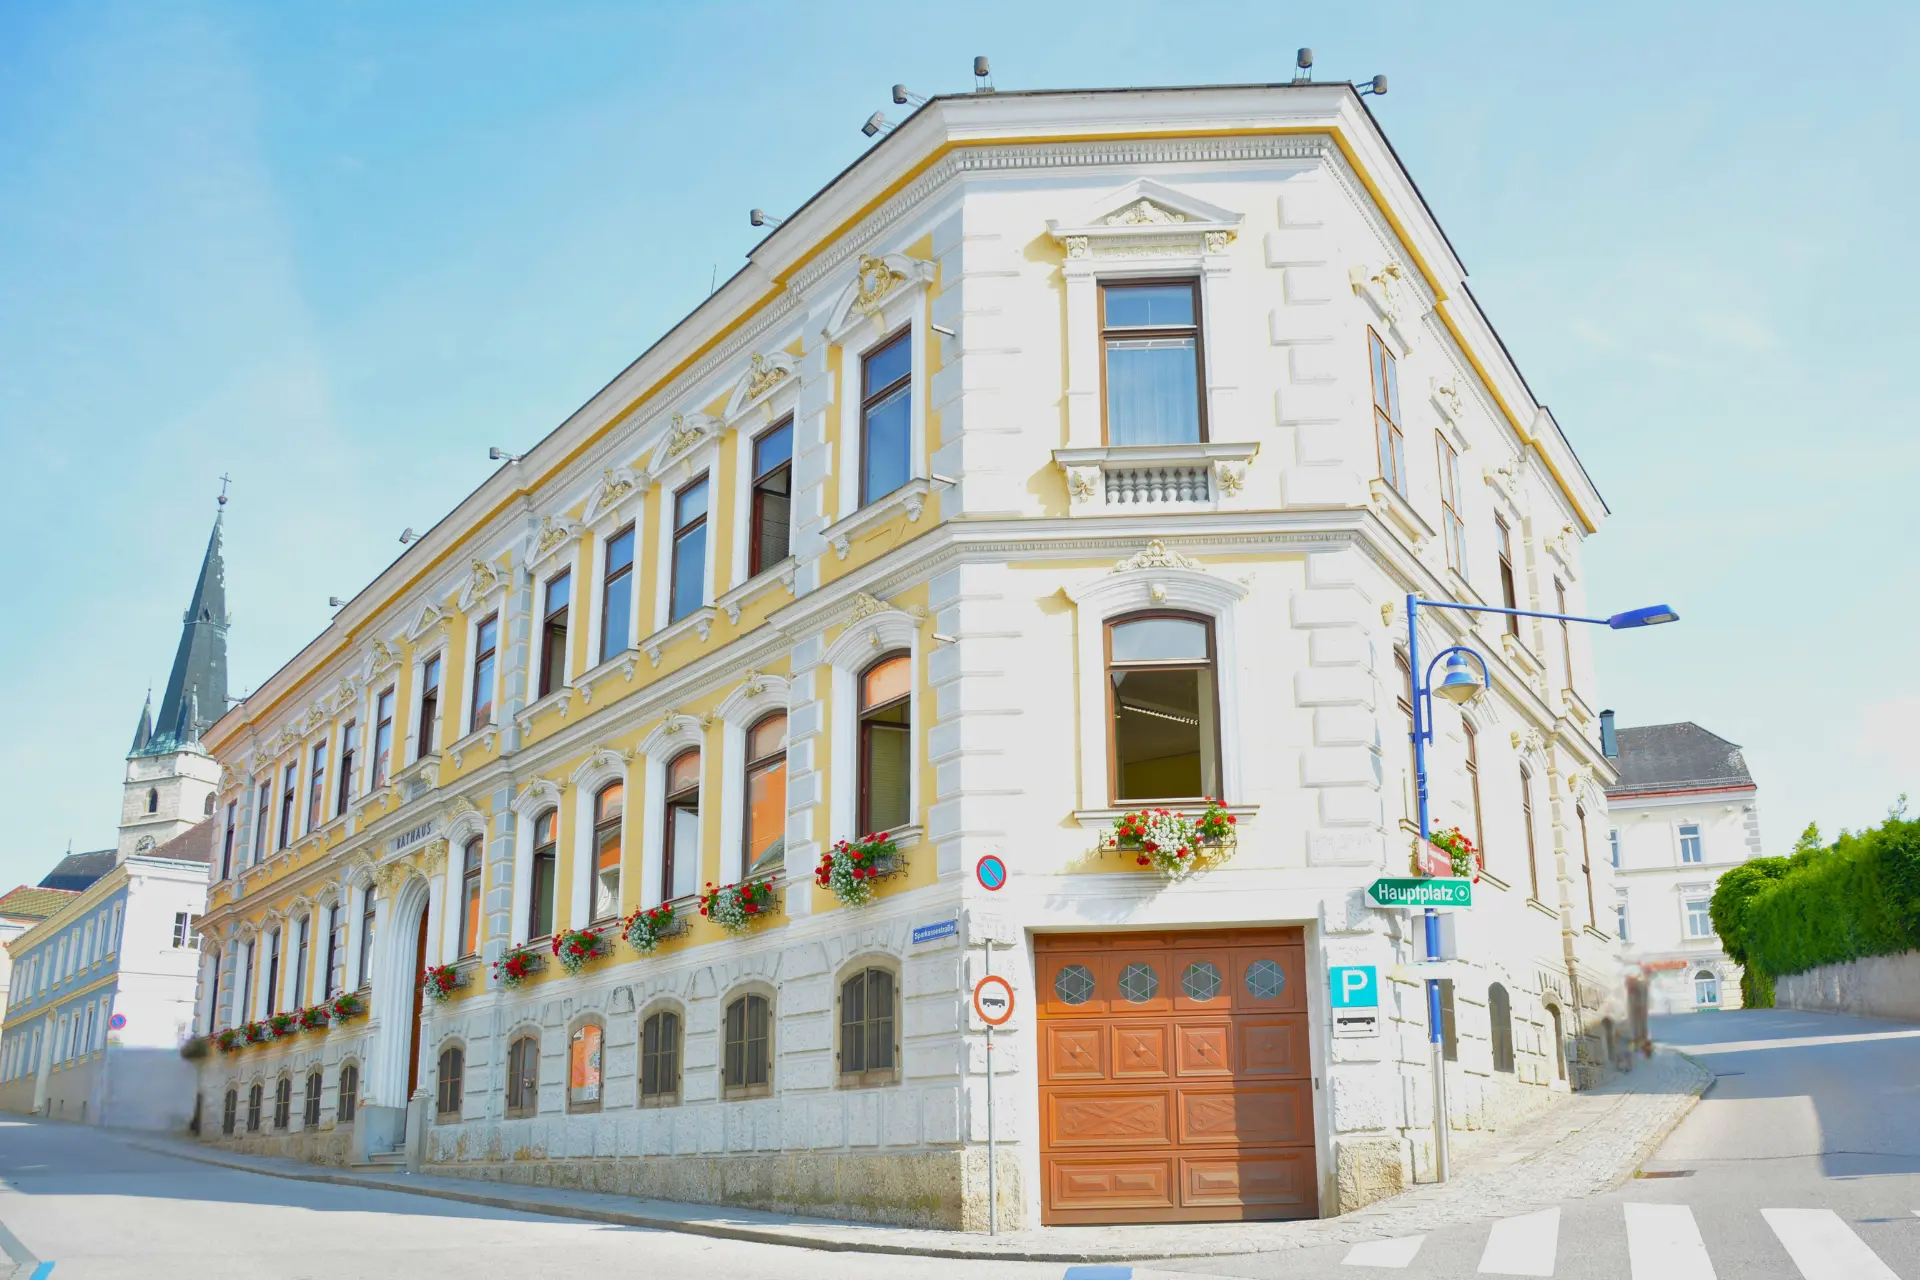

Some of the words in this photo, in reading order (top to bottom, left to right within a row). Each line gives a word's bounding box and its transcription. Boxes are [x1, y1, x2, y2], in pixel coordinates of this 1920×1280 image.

[397, 822, 431, 849] RATHAUS
[1378, 883, 1454, 904] Hauptplatz
[1342, 970, 1368, 1003] P
